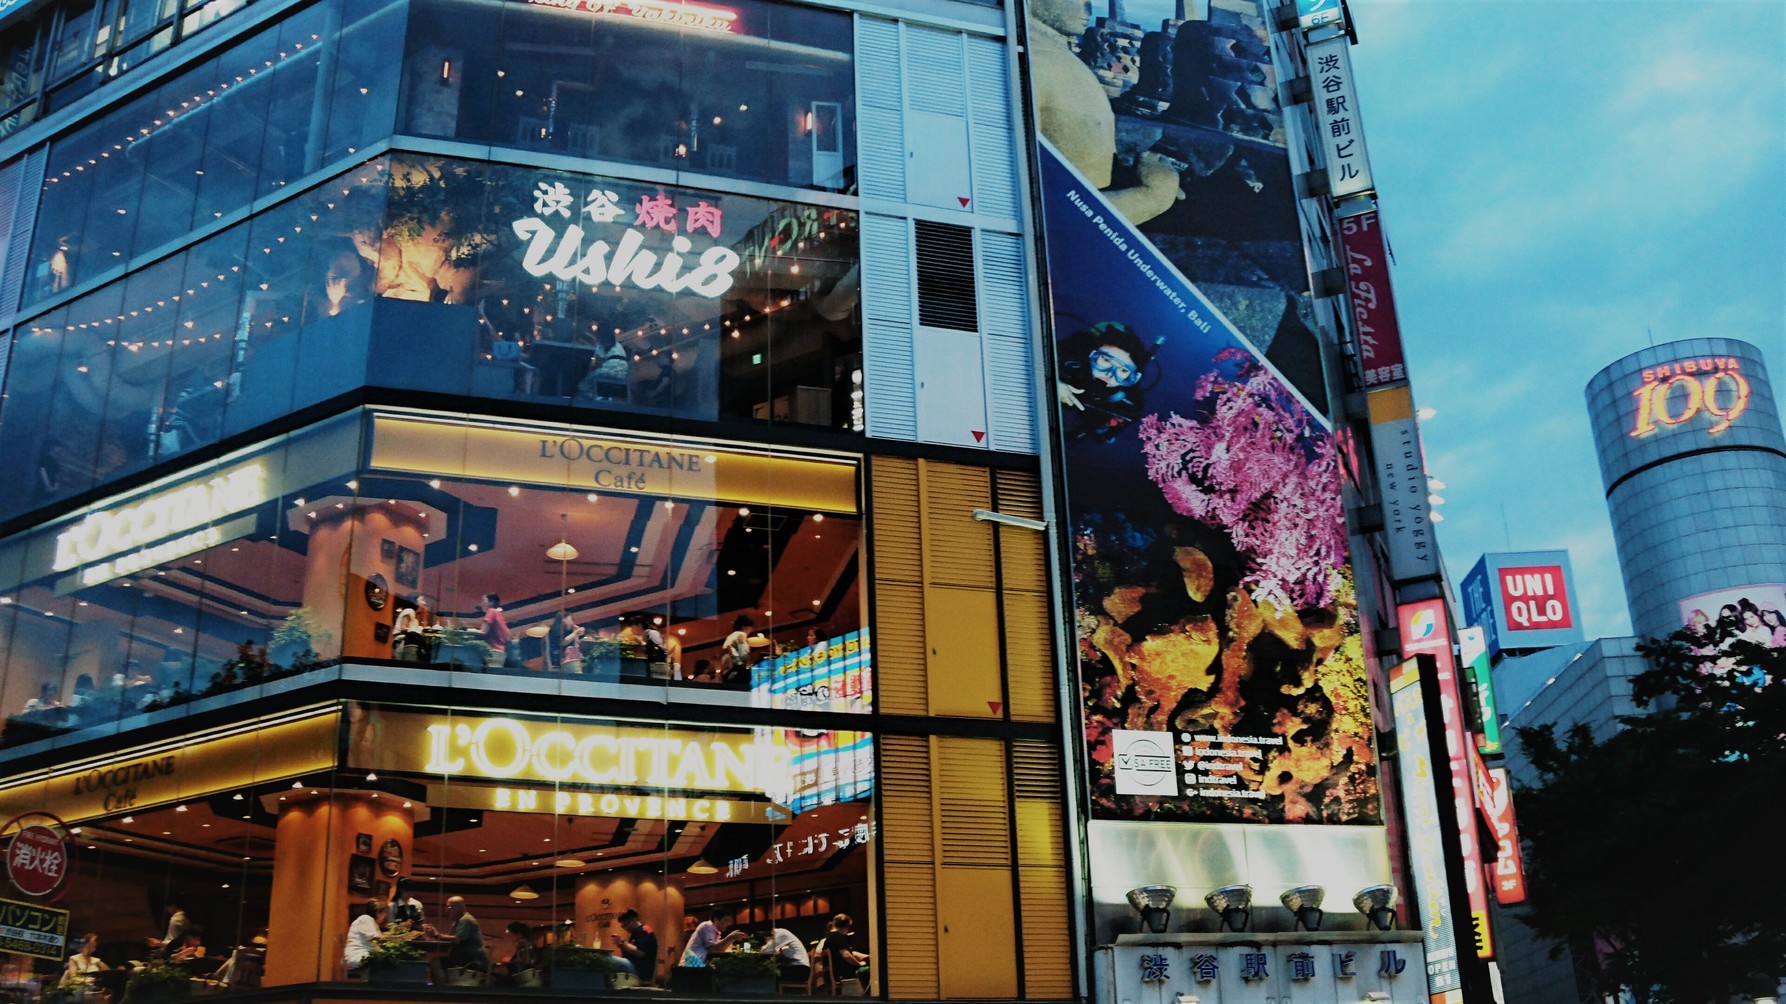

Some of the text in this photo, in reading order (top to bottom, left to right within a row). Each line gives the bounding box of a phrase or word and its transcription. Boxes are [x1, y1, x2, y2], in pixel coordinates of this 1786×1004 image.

[1317, 53, 1360, 182] 渋谷駅前ビル
[1342, 213, 1376, 235] 5F
[512, 217, 740, 298] Ushi8
[1066, 189, 1212, 334] Nusa Penida Underwater, Bali
[1345, 244, 1379, 360] La Fiesta
[1364, 363, 1406, 386] 美容室
[1641, 357, 1740, 382] SHIBUYA
[1629, 370, 1751, 438] 109
[539, 438, 702, 472] L'OCCITANE
[594, 469, 647, 490] Café
[1400, 429, 1428, 562] studio yoggy
[1386, 463, 1406, 533] new york
[1505, 573, 1555, 597] UNI
[1511, 599, 1563, 627] QLO
[72, 755, 176, 796] L'OCCITANE
[1148, 759, 1172, 769] FREE
[494, 788, 732, 821] EN PROVENCE
[13, 841, 62, 878] 消火栓
[1141, 950, 1406, 981] 渋谷駅前ビル
[1428, 959, 1456, 975] OPEN
